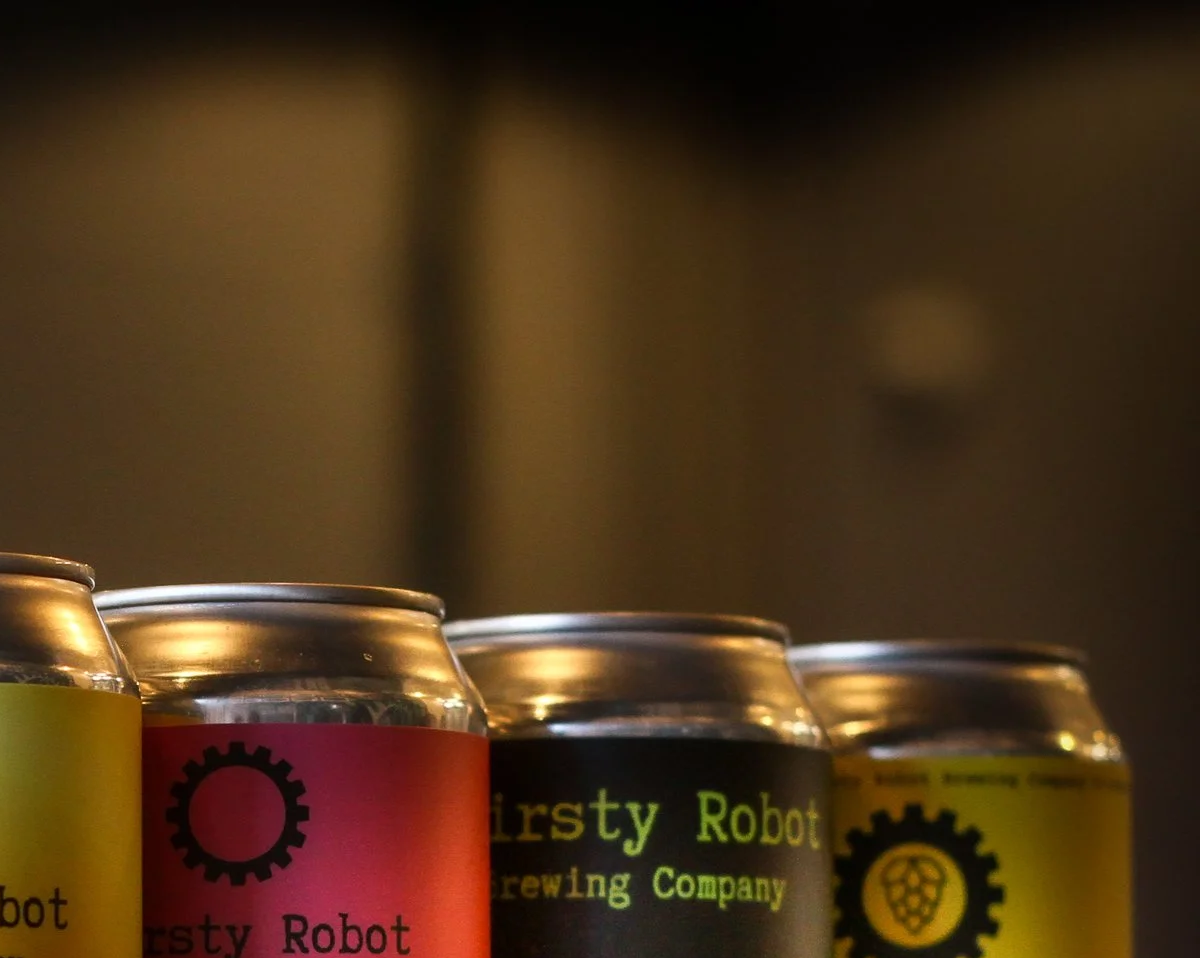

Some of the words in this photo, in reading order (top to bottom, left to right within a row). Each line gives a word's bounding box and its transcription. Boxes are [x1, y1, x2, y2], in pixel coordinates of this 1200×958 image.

[696, 790, 821, 850] Robot
[653, 866, 787, 912] Company
[282, 913, 411, 955] Robot
